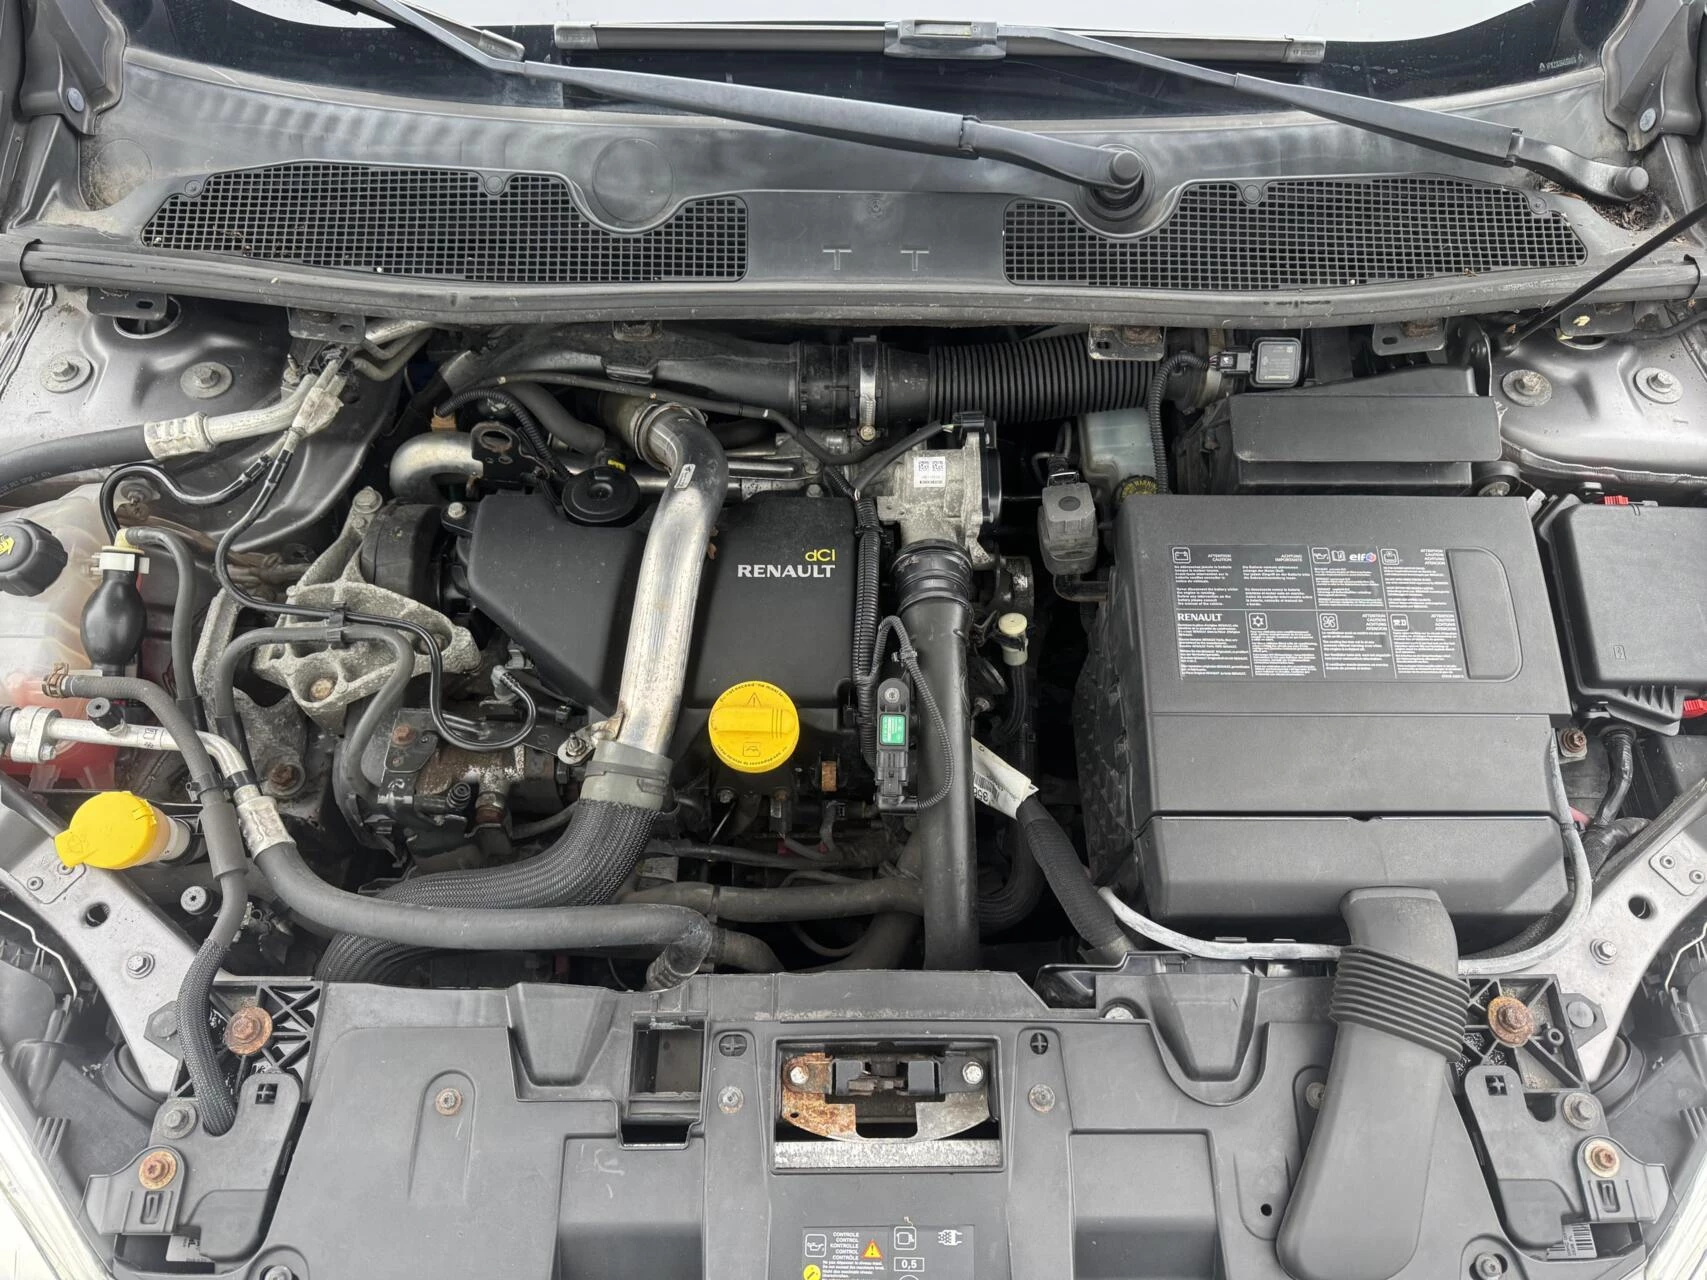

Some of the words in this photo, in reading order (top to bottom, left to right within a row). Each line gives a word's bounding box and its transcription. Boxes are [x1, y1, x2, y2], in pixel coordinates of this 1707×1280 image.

[1349, 552, 1367, 561] elf
[737, 564, 836, 578] RENAULT
[1177, 613, 1223, 621] RENAULT
[901, 1259, 918, 1270] 0,5
